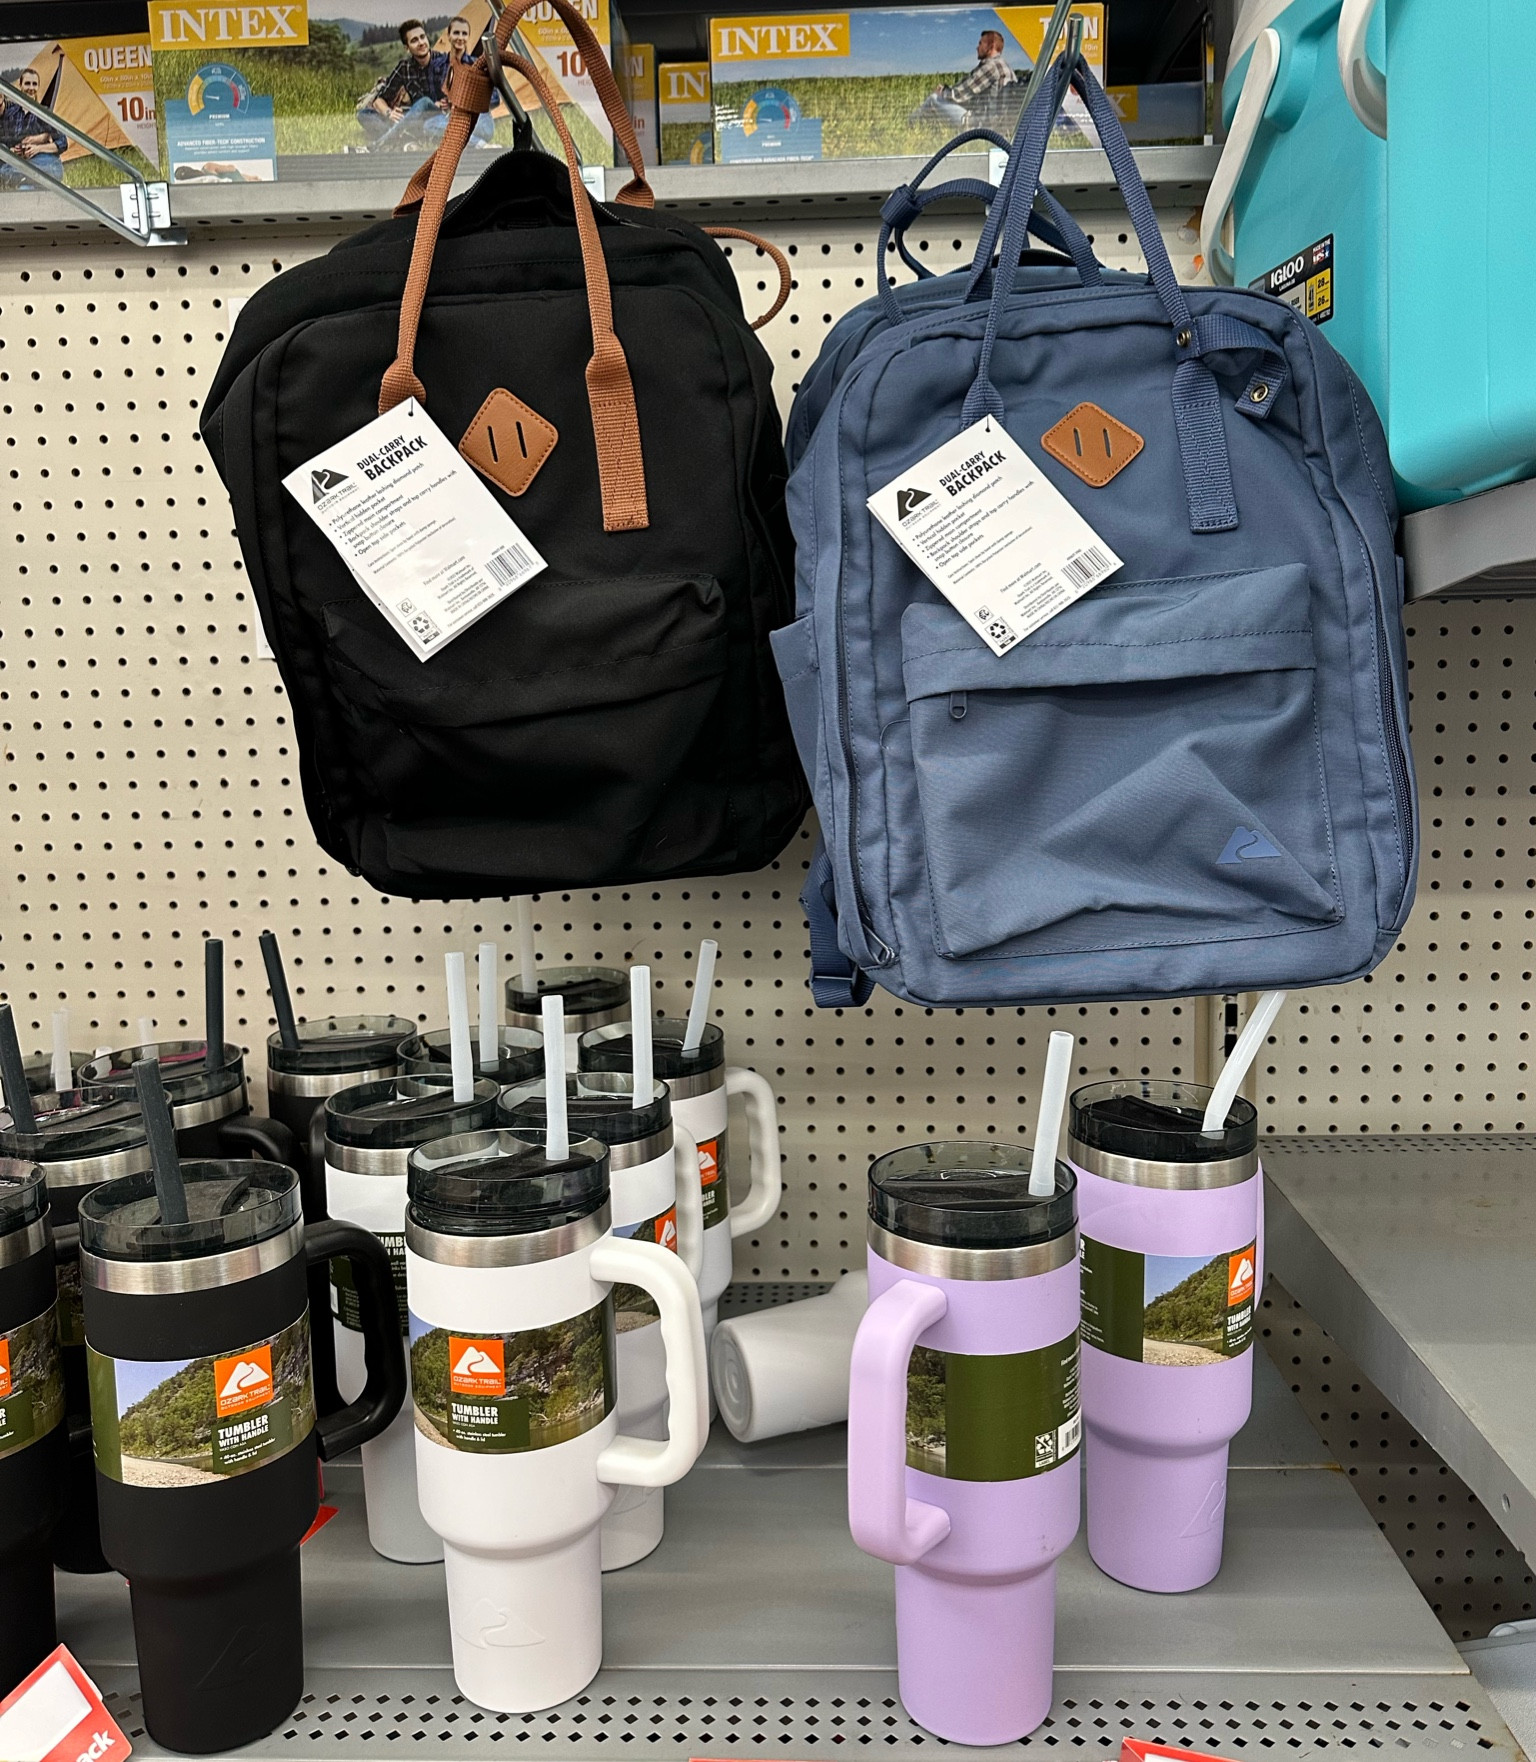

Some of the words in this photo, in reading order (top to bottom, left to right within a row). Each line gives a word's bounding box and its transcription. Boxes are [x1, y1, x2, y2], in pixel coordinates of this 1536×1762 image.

[158, 5, 298, 43] INTEX
[718, 23, 838, 57] INTEX
[84, 44, 152, 74] QUEEN
[117, 96, 156, 122] 10in
[1270, 255, 1304, 289] IGLOO
[356, 434, 405, 470] DUAL-CARRY
[363, 435, 428, 481] BACKPACK
[938, 450, 985, 487] DUAL-CARRY
[945, 450, 1006, 497] BACKPACK
[353, 506, 371, 518] hidden
[370, 496, 386, 510] pocket
[375, 494, 404, 515] compartment
[954, 508, 982, 530] compartment
[914, 519, 943, 540] Polyurethane
[941, 508, 957, 520] leather
[919, 530, 937, 545] Vertical
[935, 522, 951, 534] hidden
[950, 511, 965, 524] pocket
[357, 544, 372, 555] Open
[929, 540, 951, 557] Backpack
[938, 557, 952, 567] Open
[967, 534, 984, 548] pockets
[451, 1402, 498, 1417] TUMBLER
[452, 1413, 470, 1423] WITH
[470, 1416, 499, 1425] HANDLE
[218, 1414, 269, 1440] TUMBLER
[219, 1434, 240, 1448] WITH
[241, 1425, 269, 1442] HANDLE
